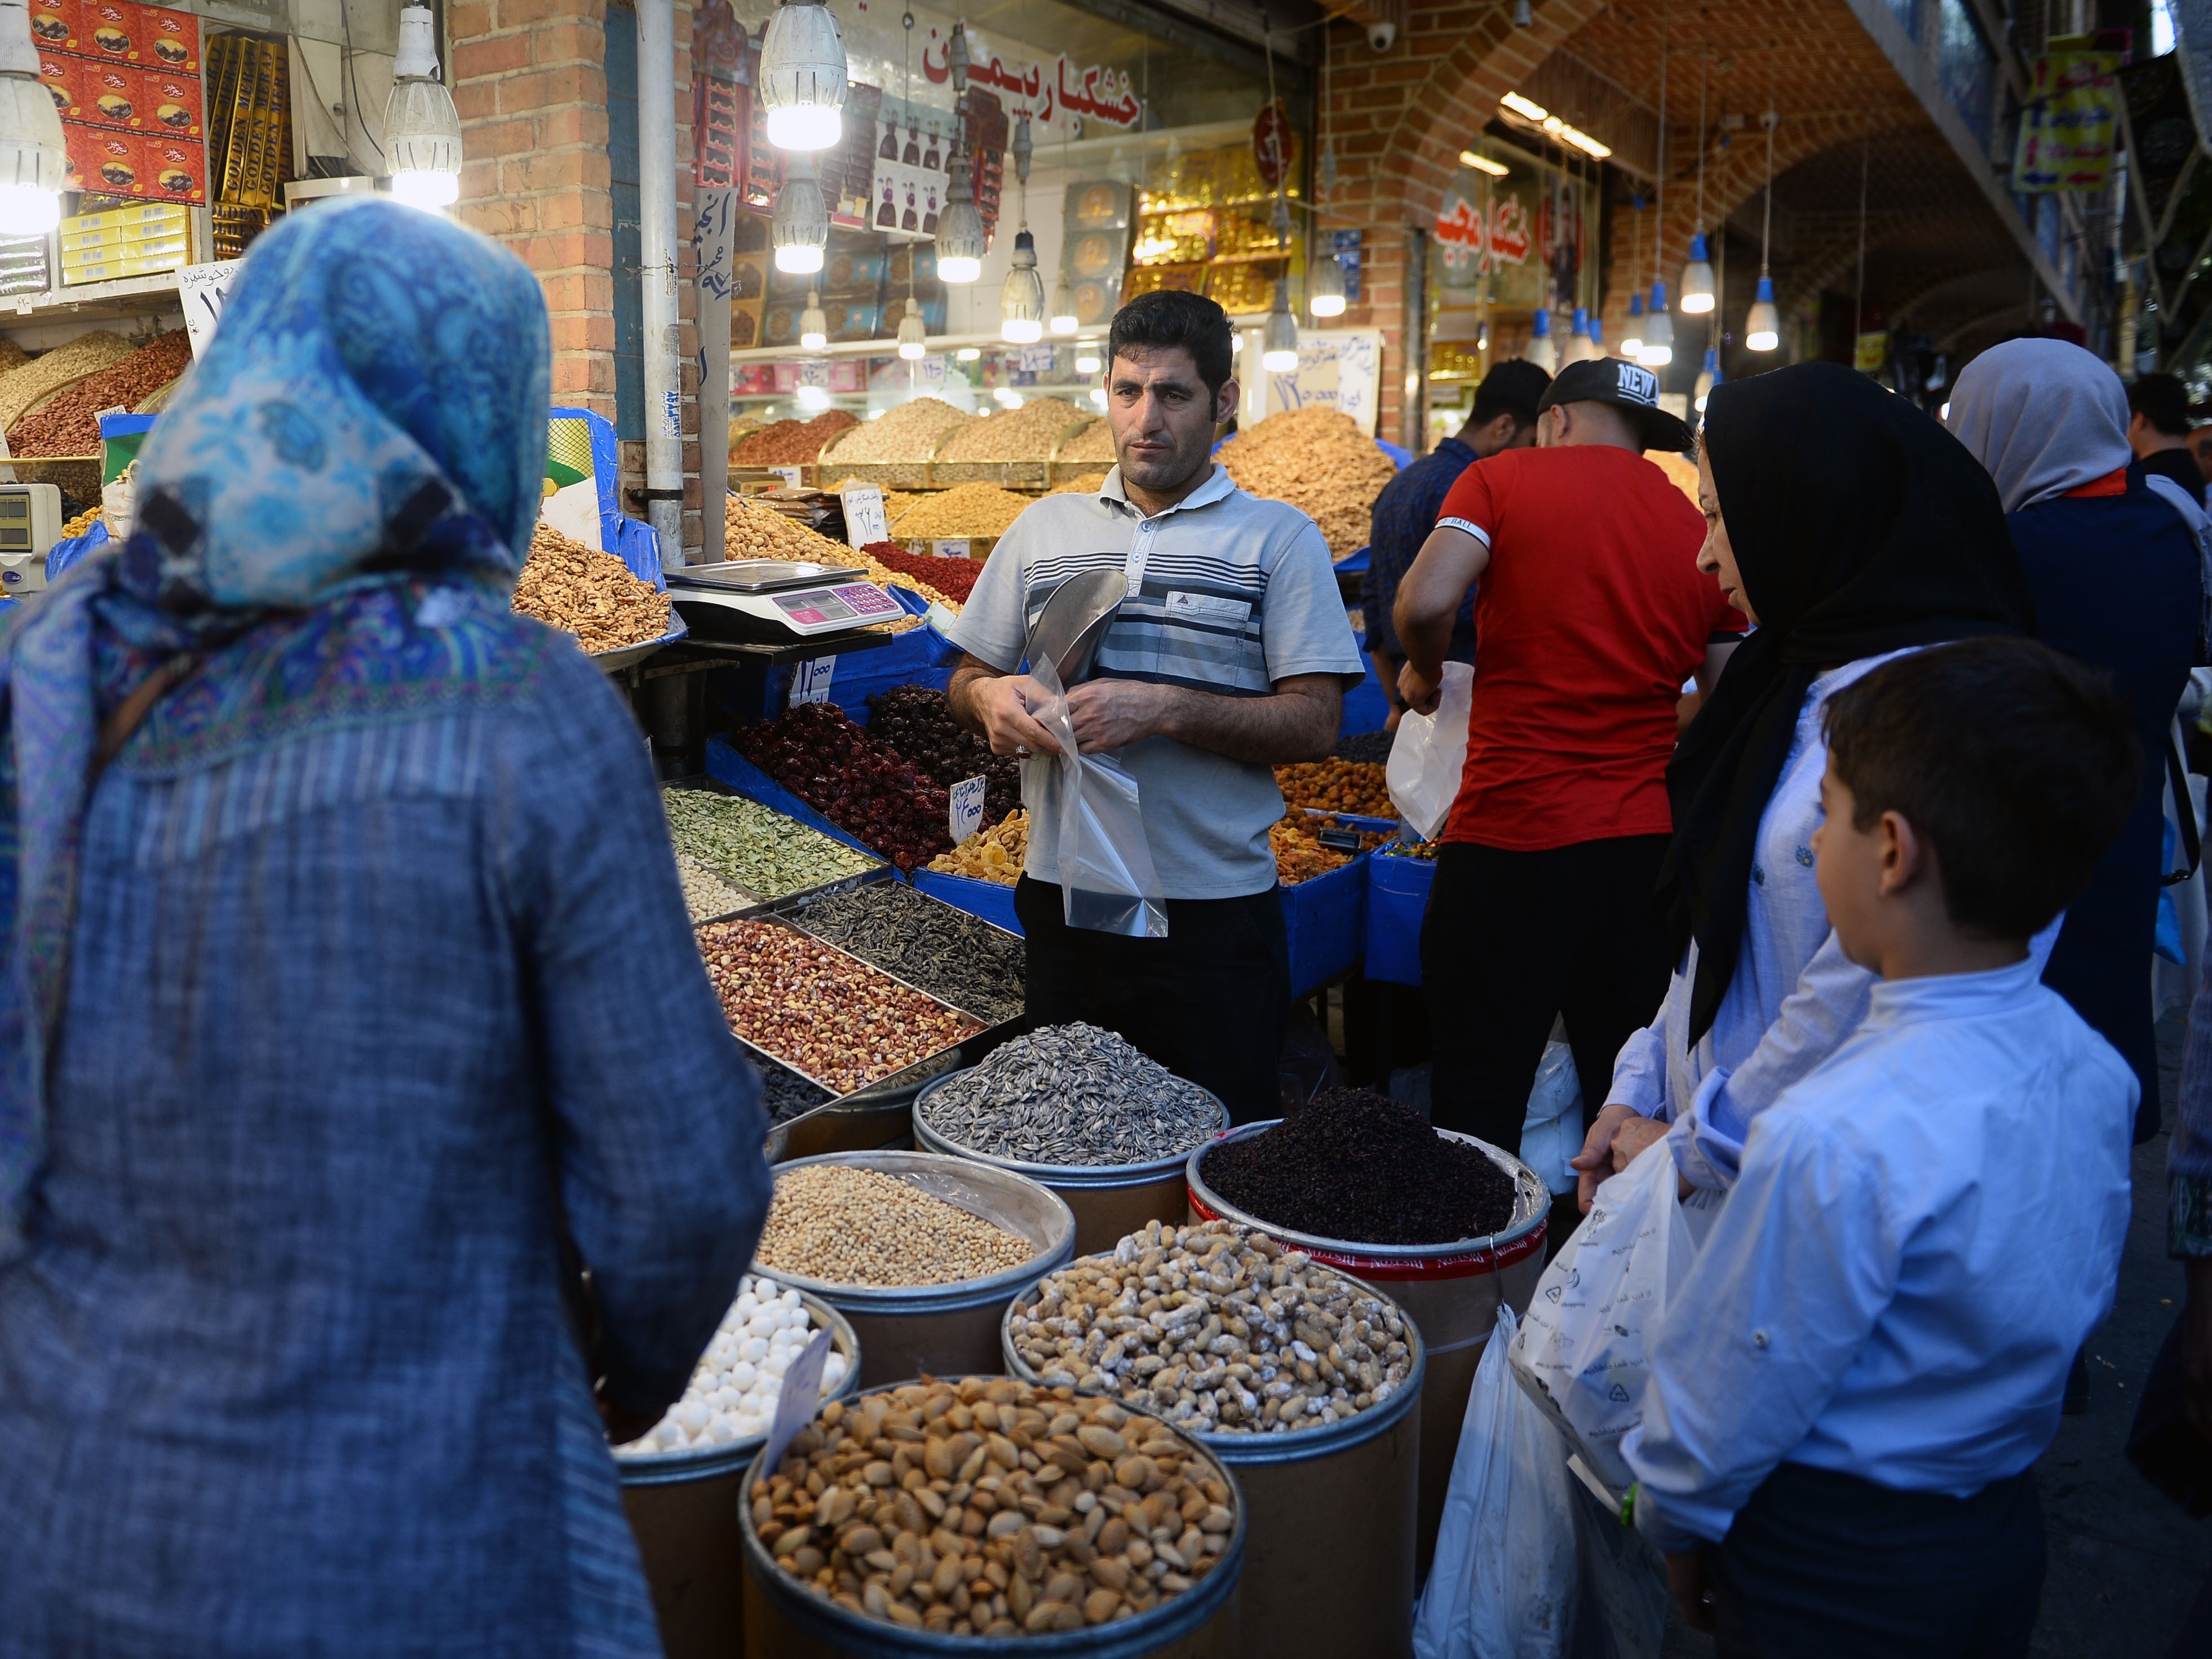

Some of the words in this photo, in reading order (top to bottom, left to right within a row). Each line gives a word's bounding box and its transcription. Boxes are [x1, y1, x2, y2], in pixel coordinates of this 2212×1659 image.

[227, 117, 247, 191] GOLDEN
[238, 50, 255, 109] MERAJ
[246, 118, 264, 191] GOLDEN
[255, 50, 272, 108] MERAJ
[260, 122, 279, 195] GOLDEN
[271, 56, 287, 114] MERAJ
[1617, 363, 1655, 398] NEW
